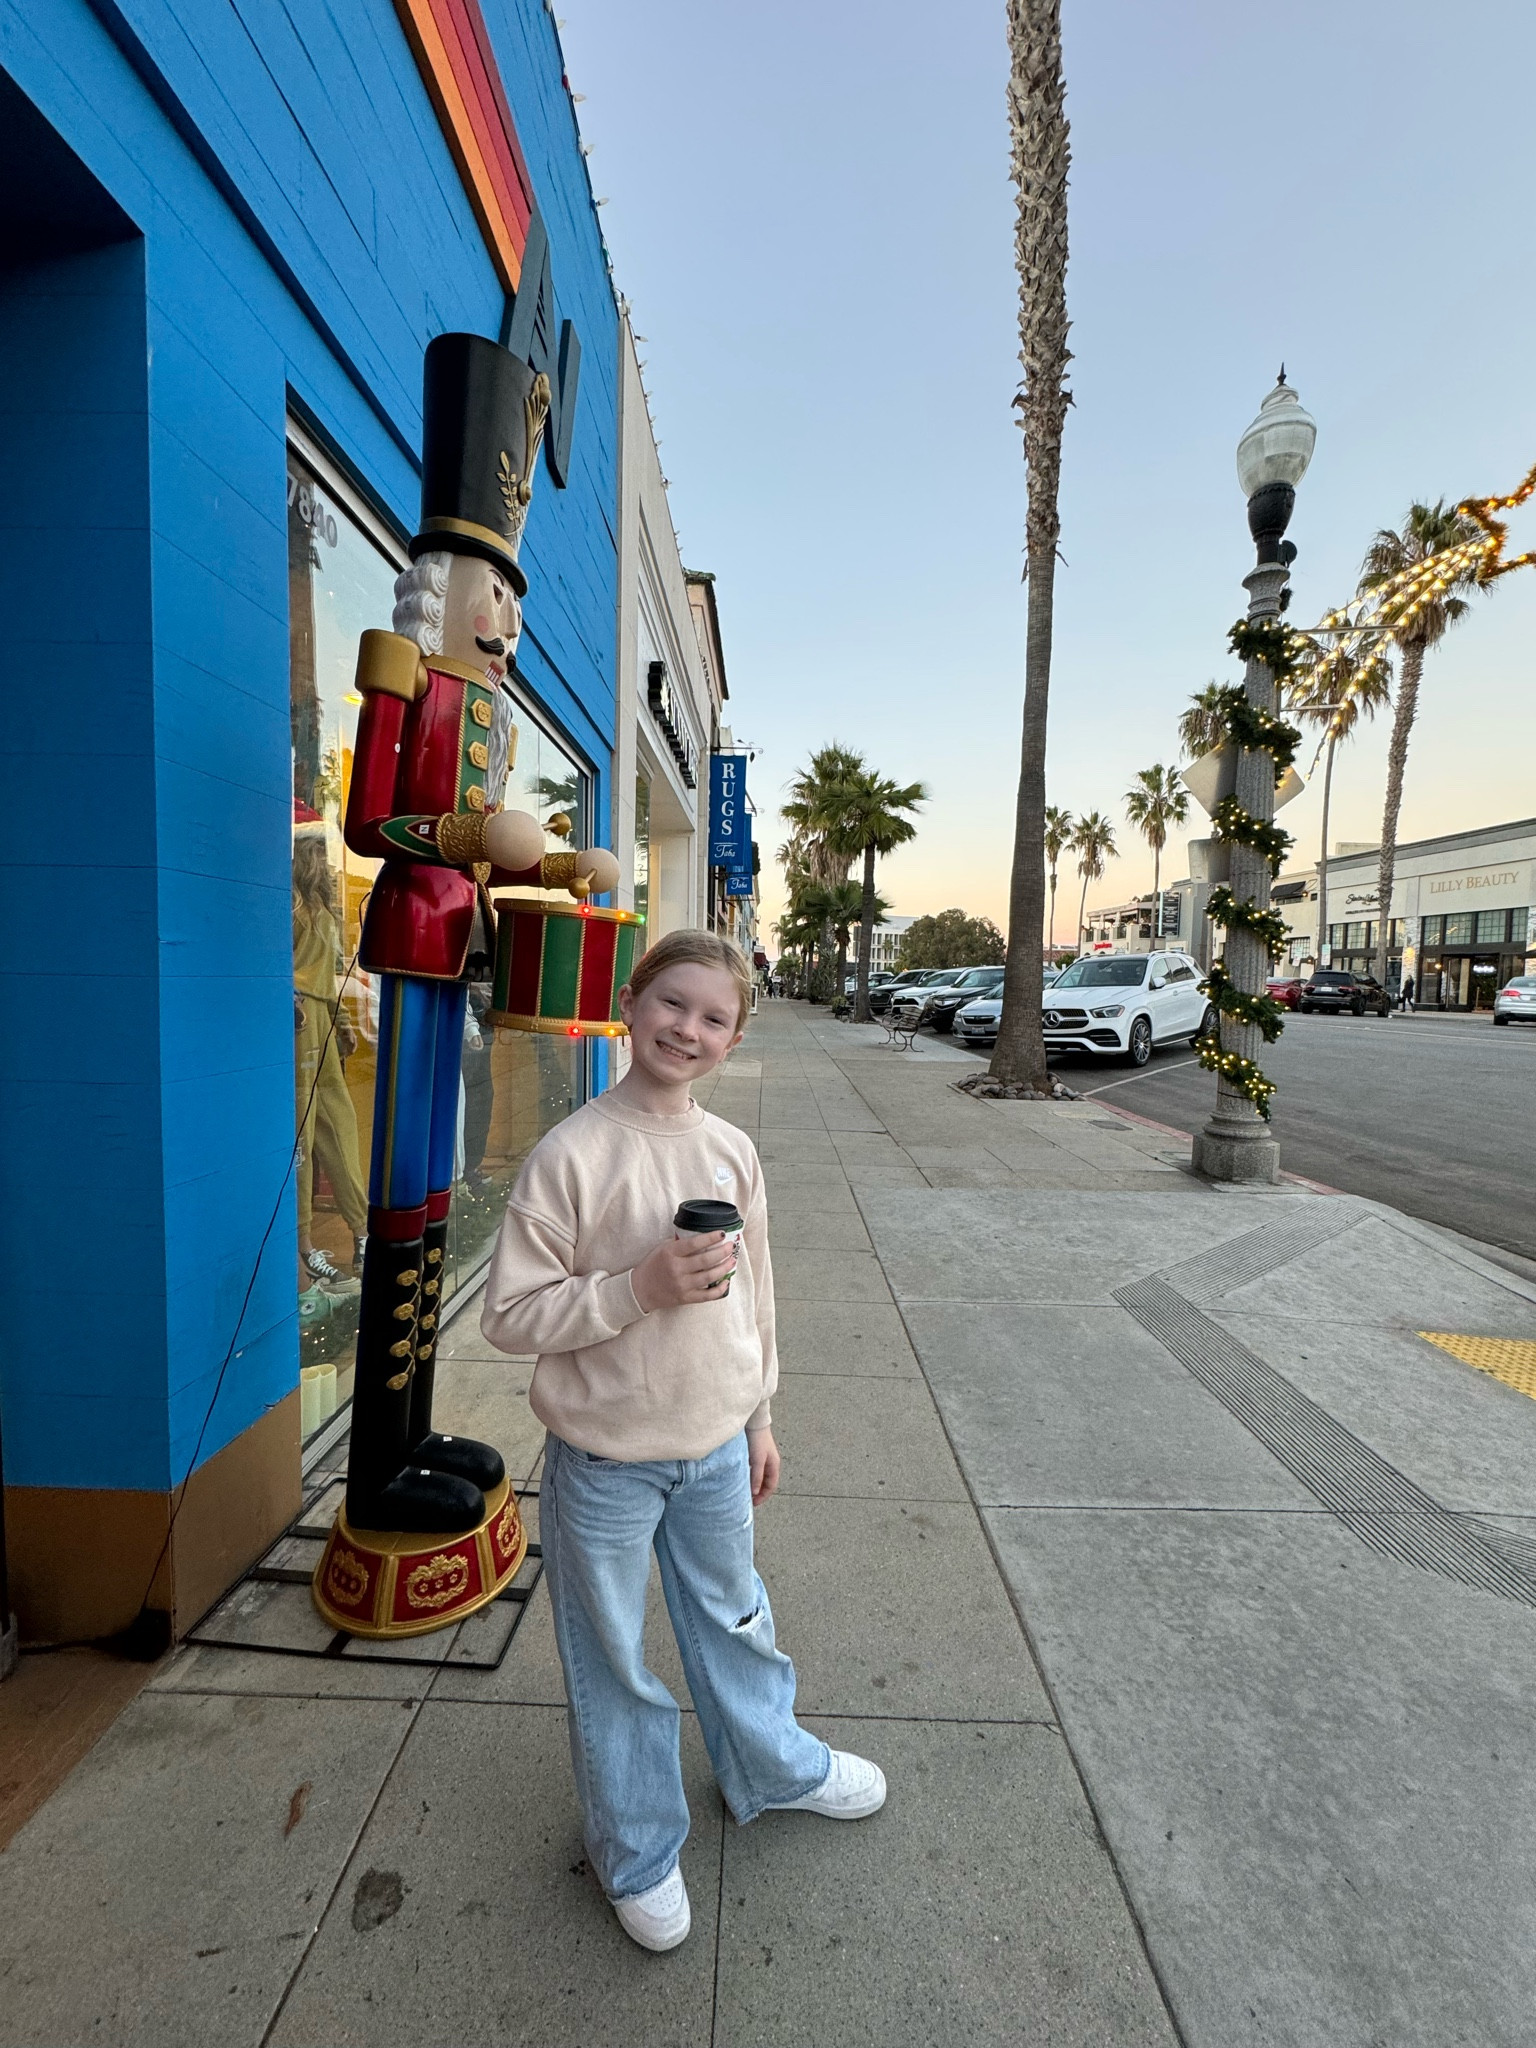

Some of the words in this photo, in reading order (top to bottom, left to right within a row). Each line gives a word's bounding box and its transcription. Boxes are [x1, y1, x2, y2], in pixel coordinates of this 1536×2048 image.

[721, 762, 737, 836] RUGS
[1429, 879, 1463, 894] LILLY
[1466, 870, 1520, 889] BEAUTY
